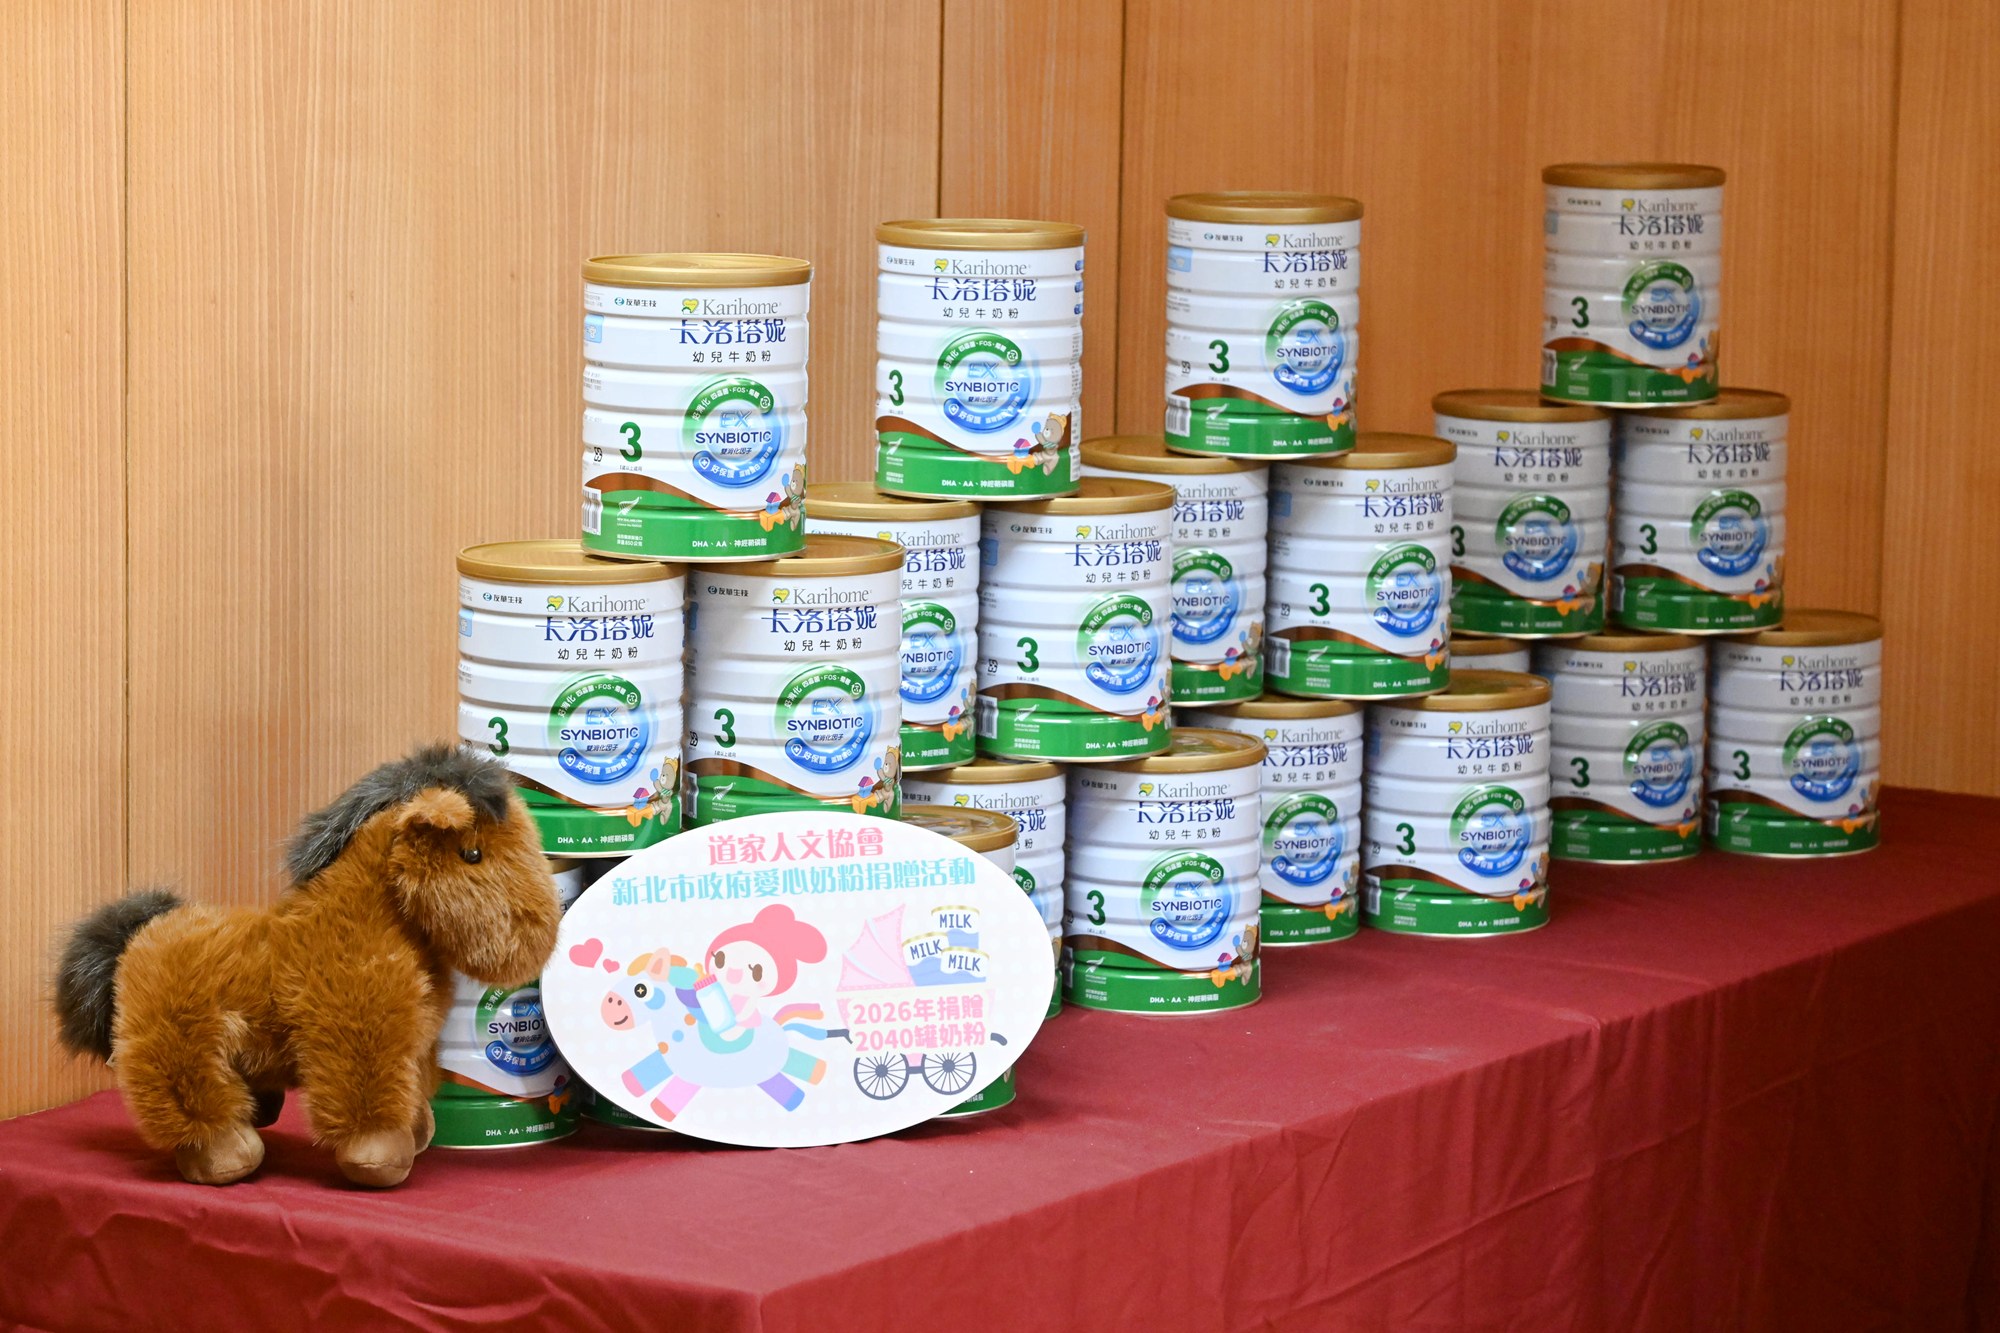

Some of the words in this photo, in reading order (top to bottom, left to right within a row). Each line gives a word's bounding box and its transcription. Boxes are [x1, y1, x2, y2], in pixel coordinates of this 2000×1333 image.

[1612, 215, 1704, 235] 卡洛塔妮
[1283, 233, 1343, 248] Karihome
[952, 259, 1027, 275] Karihome
[1255, 250, 1348, 272] 卡洛塔妮
[925, 278, 1036, 301] 卡洛塔妮
[1275, 277, 1337, 288] 幼兒牛奶粉
[626, 298, 656, 307] 友華生技
[703, 299, 778, 315] Karihome
[943, 308, 1018, 319] 幼兒牛奶粉
[1571, 297, 1589, 328] 3
[670, 319, 786, 344] 卡洛塔妮
[693, 351, 771, 363] 幼兒牛奶粉
[1208, 340, 1229, 373] 3
[1276, 346, 1336, 358] SYNBIOTIC
[889, 370, 904, 406] 3
[945, 382, 1018, 392] SYNBIOTIC
[721, 411, 751, 428] EX
[619, 422, 642, 462] 3
[695, 431, 771, 444] SYNBIOTIC
[721, 447, 752, 455] 雙消化因子
[711, 464, 734, 479] 好保護
[1383, 478, 1439, 493] Karihome
[1173, 500, 1244, 522] 洛塔妮
[1356, 494, 1444, 518] 卡洛塔妮
[1094, 524, 1156, 540] Karihome
[1178, 527, 1231, 538] 兒牛奶粉
[1374, 522, 1434, 533] 幼兒牛奶粉
[896, 531, 960, 546] Karihome
[1451, 525, 1465, 556] 3
[1640, 524, 1657, 555] 3
[906, 548, 966, 572] 洛塔妮
[1065, 540, 1161, 567] 卡洛塔妮
[902, 578, 954, 590] 兒牛奶粉
[1086, 570, 1151, 583] 幼兒牛奶粉
[493, 595, 522, 604] 友華生技
[719, 588, 748, 597] 友華生技
[793, 588, 869, 605] Karihome
[1173, 595, 1231, 606] YNBIOTIC
[1309, 584, 1330, 616] 3
[1377, 587, 1434, 600] SYNBIOTIC
[567, 596, 646, 612] Karihome
[761, 606, 877, 633] 卡洛塔妮
[536, 615, 654, 641] 卡洛塔妮
[784, 638, 862, 652] 幼兒牛奶粉
[1088, 642, 1150, 656] SYNBIOTIC
[557, 647, 638, 660] 幼兒牛奶粉
[901, 650, 953, 662] NBIOTIC
[1017, 637, 1039, 673] 3
[1799, 654, 1857, 668] Karihome
[811, 697, 843, 715] EX
[585, 707, 617, 725] EX
[787, 717, 862, 731] SYNBIOTIC
[561, 727, 638, 740] SYNBIOTIC
[714, 708, 736, 748] 3
[1466, 720, 1527, 735] Karihome
[488, 717, 509, 757] 3
[812, 733, 843, 742] 雙消化因子
[1281, 729, 1342, 743] Karihome
[586, 743, 618, 751] 雙消化因子
[1438, 736, 1533, 759] 卡洛塔妮
[803, 751, 826, 765] 好保護
[1733, 751, 1750, 780] 3
[1458, 762, 1521, 774] 幼兒牛奶粉
[1570, 757, 1590, 788] 3
[1273, 772, 1336, 782] 幼兒牛奶粉
[1158, 783, 1228, 798] Karihome
[972, 793, 1040, 809] Karihome
[1129, 801, 1235, 824] 卡洛塔妮
[1149, 829, 1221, 840] 幼兒牛奶粉
[1396, 823, 1415, 855] 3
[1461, 829, 1521, 841] SYNBIOTIC
[708, 827, 884, 865] 道家人文協會
[1274, 837, 1335, 849] SYNBIOTIC
[611, 858, 976, 906] 新北市政府愛心奶粉捐贈活動
[1087, 890, 1106, 925] 3
[1152, 899, 1222, 911] SYNBIOTIC
[940, 914, 972, 928] MILK
[910, 940, 942, 959] MILK
[948, 954, 981, 971] MILK
[853, 995, 983, 1024] 2026年捐贈
[855, 1022, 986, 1052] 2040罐奶粉
